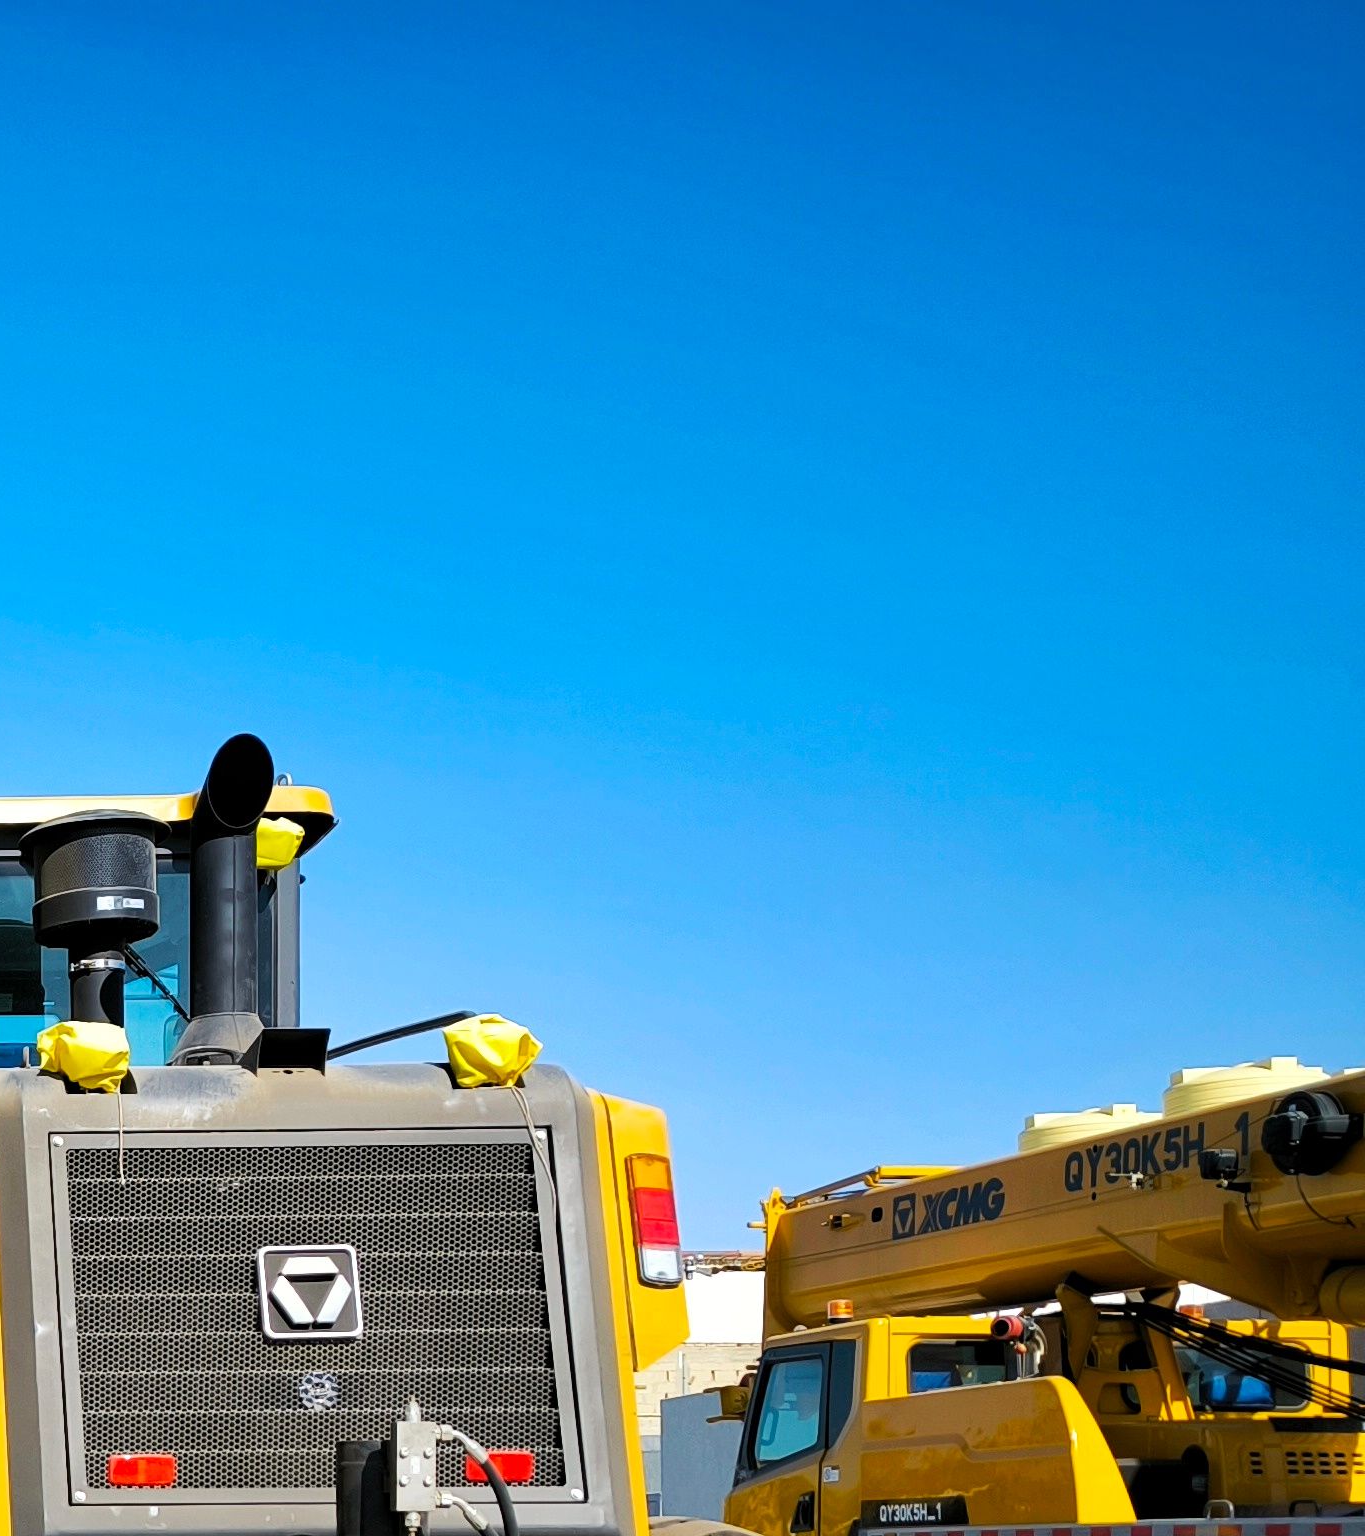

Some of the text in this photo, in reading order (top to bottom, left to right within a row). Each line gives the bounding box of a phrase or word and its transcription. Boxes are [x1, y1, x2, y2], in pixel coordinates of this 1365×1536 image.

[1064, 1122, 1205, 1193] QY30K5H
[917, 1177, 1006, 1235] XCMG
[879, 1502, 942, 1523] QY30K5H_1
